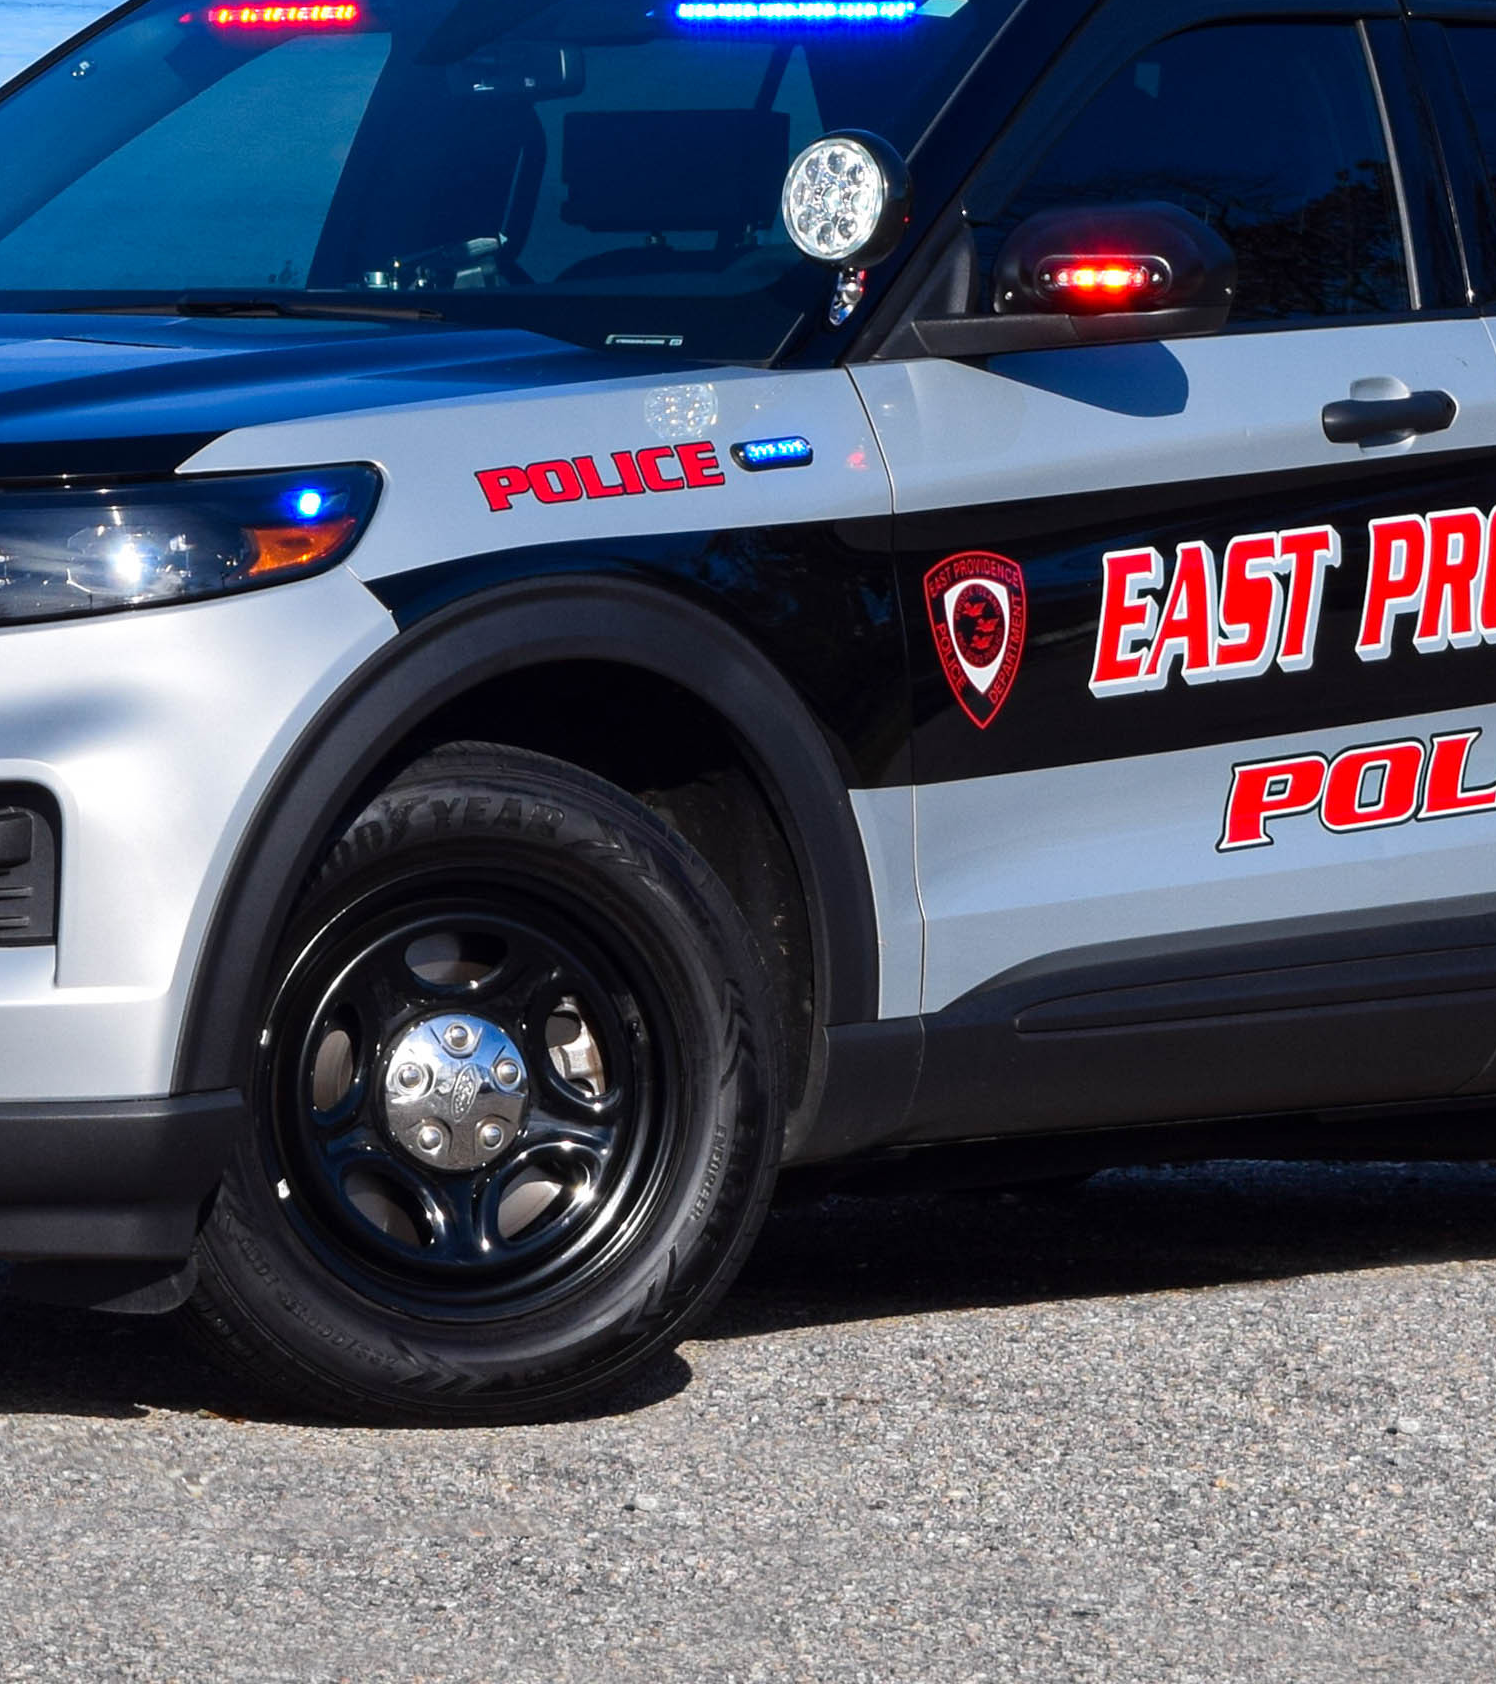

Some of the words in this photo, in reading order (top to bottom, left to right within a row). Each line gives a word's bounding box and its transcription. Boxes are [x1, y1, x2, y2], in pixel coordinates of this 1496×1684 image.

[475, 441, 725, 512] POLICE
[928, 566, 952, 599] EAST
[953, 557, 1020, 589] PROVIDENCE
[1089, 524, 1340, 697] EAST
[934, 621, 968, 694] POLICE
[987, 592, 1023, 705] DEPARTMENT
